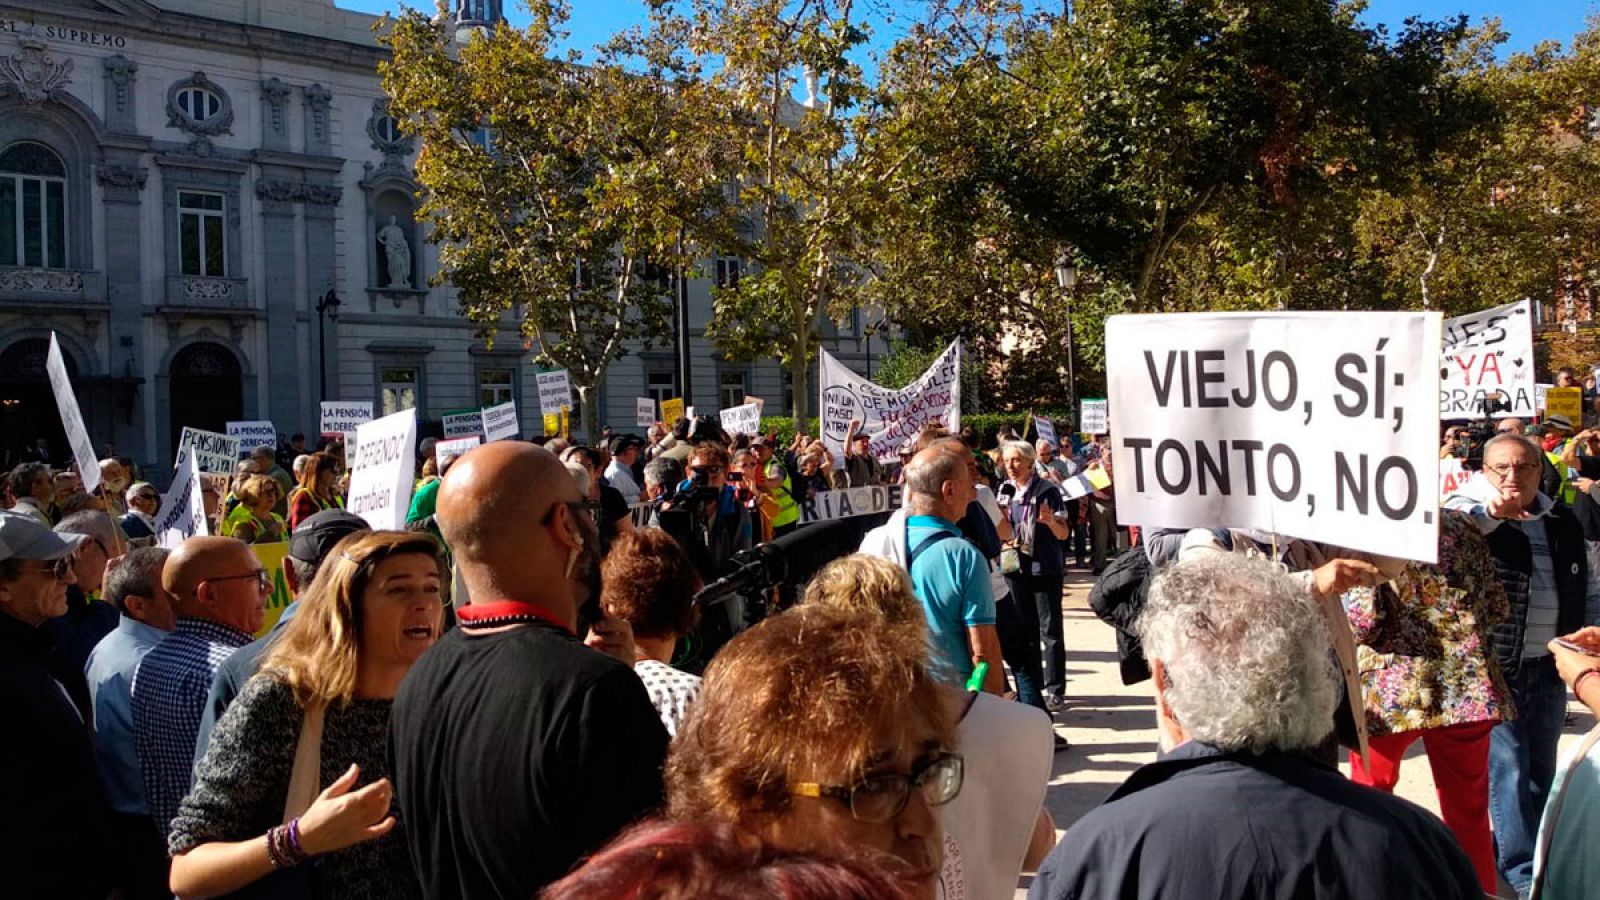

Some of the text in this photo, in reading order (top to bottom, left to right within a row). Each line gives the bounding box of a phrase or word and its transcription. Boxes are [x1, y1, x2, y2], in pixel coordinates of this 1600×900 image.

[46, 25, 126, 48] SUPREMO
[1143, 337, 1405, 433] VIEJO, SÍ;
[863, 395, 887, 410] DE
[324, 407, 372, 419] LA PENSIÓN,
[446, 415, 453, 424] LA
[828, 406, 853, 420] PASO
[229, 427, 239, 436] LA
[324, 423, 332, 432] MI
[824, 420, 850, 432] ATRA
[183, 429, 239, 458] PENSIONES
[1123, 437, 1433, 525] TONTO, NO.
